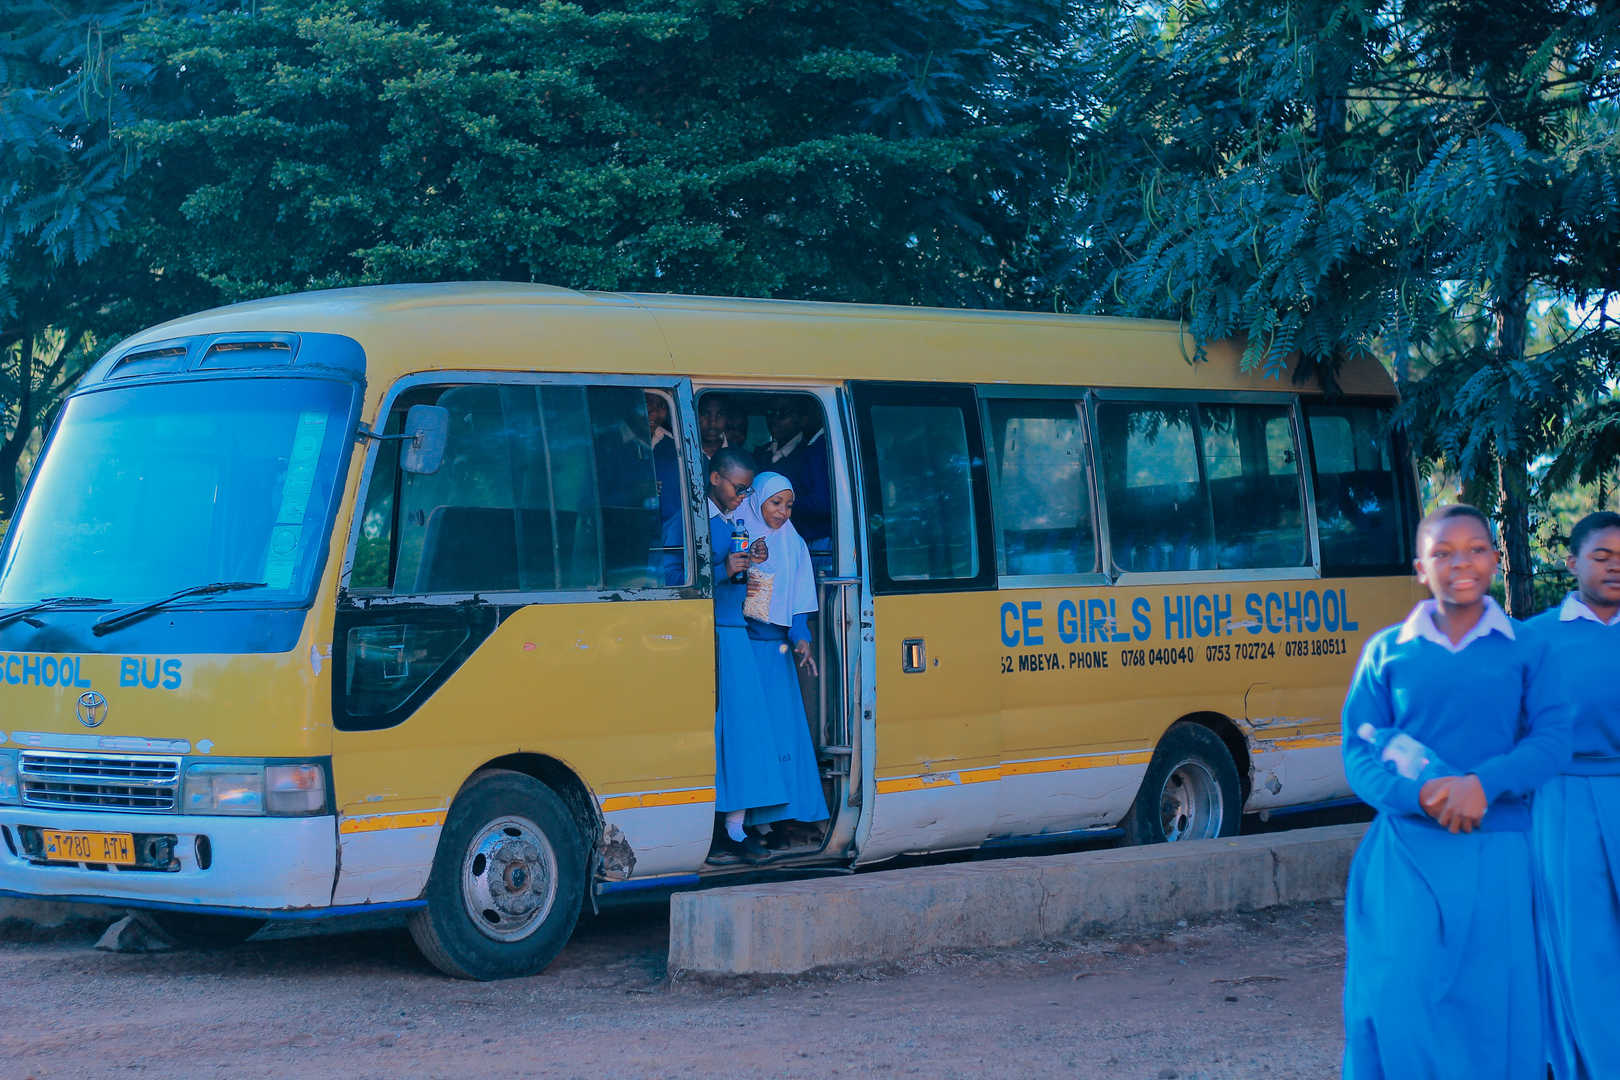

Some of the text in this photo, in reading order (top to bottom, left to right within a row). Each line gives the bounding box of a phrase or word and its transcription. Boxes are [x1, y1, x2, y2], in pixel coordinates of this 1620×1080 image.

[1000, 588, 1359, 647] CE GIRLS HIGH SCHOOL
[1069, 651, 1108, 669] PHONE
[1121, 649, 1145, 667] 0768
[1148, 646, 1194, 666] 040040
[1206, 644, 1231, 662] 0753
[1235, 642, 1275, 660] 702724
[1285, 640, 1309, 657] 0783
[1311, 638, 1347, 656] 180511
[119, 656, 183, 690] BUS
